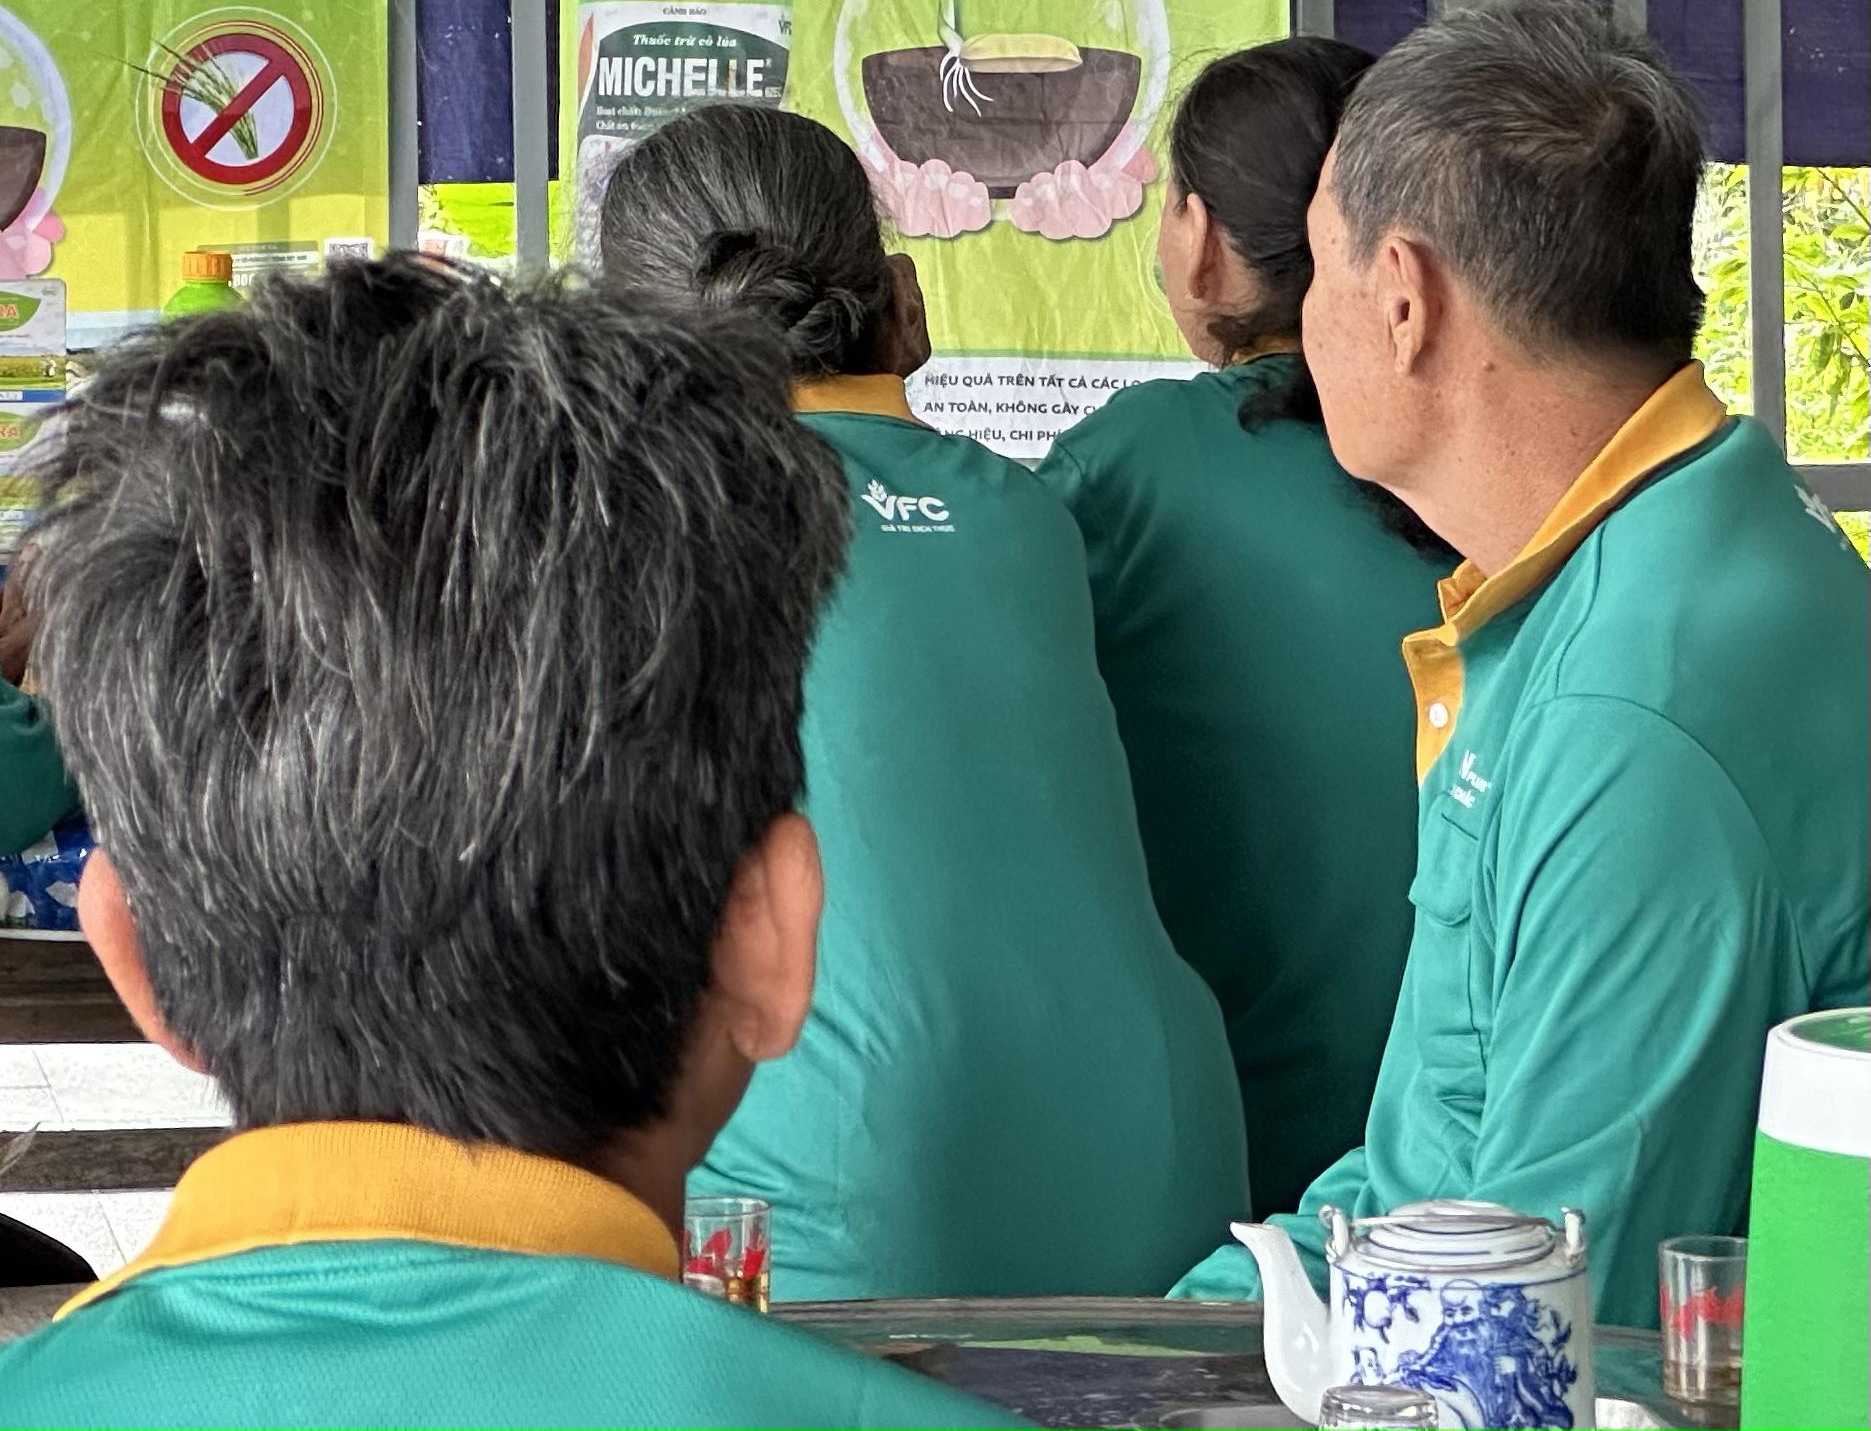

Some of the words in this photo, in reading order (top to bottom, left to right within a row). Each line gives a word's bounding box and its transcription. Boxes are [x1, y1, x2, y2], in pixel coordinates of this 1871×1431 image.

[598, 56, 766, 98] MICHELLE
[925, 375, 958, 387] HIỆU
[998, 373, 1035, 386] TRÊN
[1091, 376, 1119, 389] CÁC
[924, 402, 944, 413] AN
[996, 400, 1047, 413] KHÔNG
[1010, 432, 1033, 441] CHI
[860, 494, 950, 521] VFC
